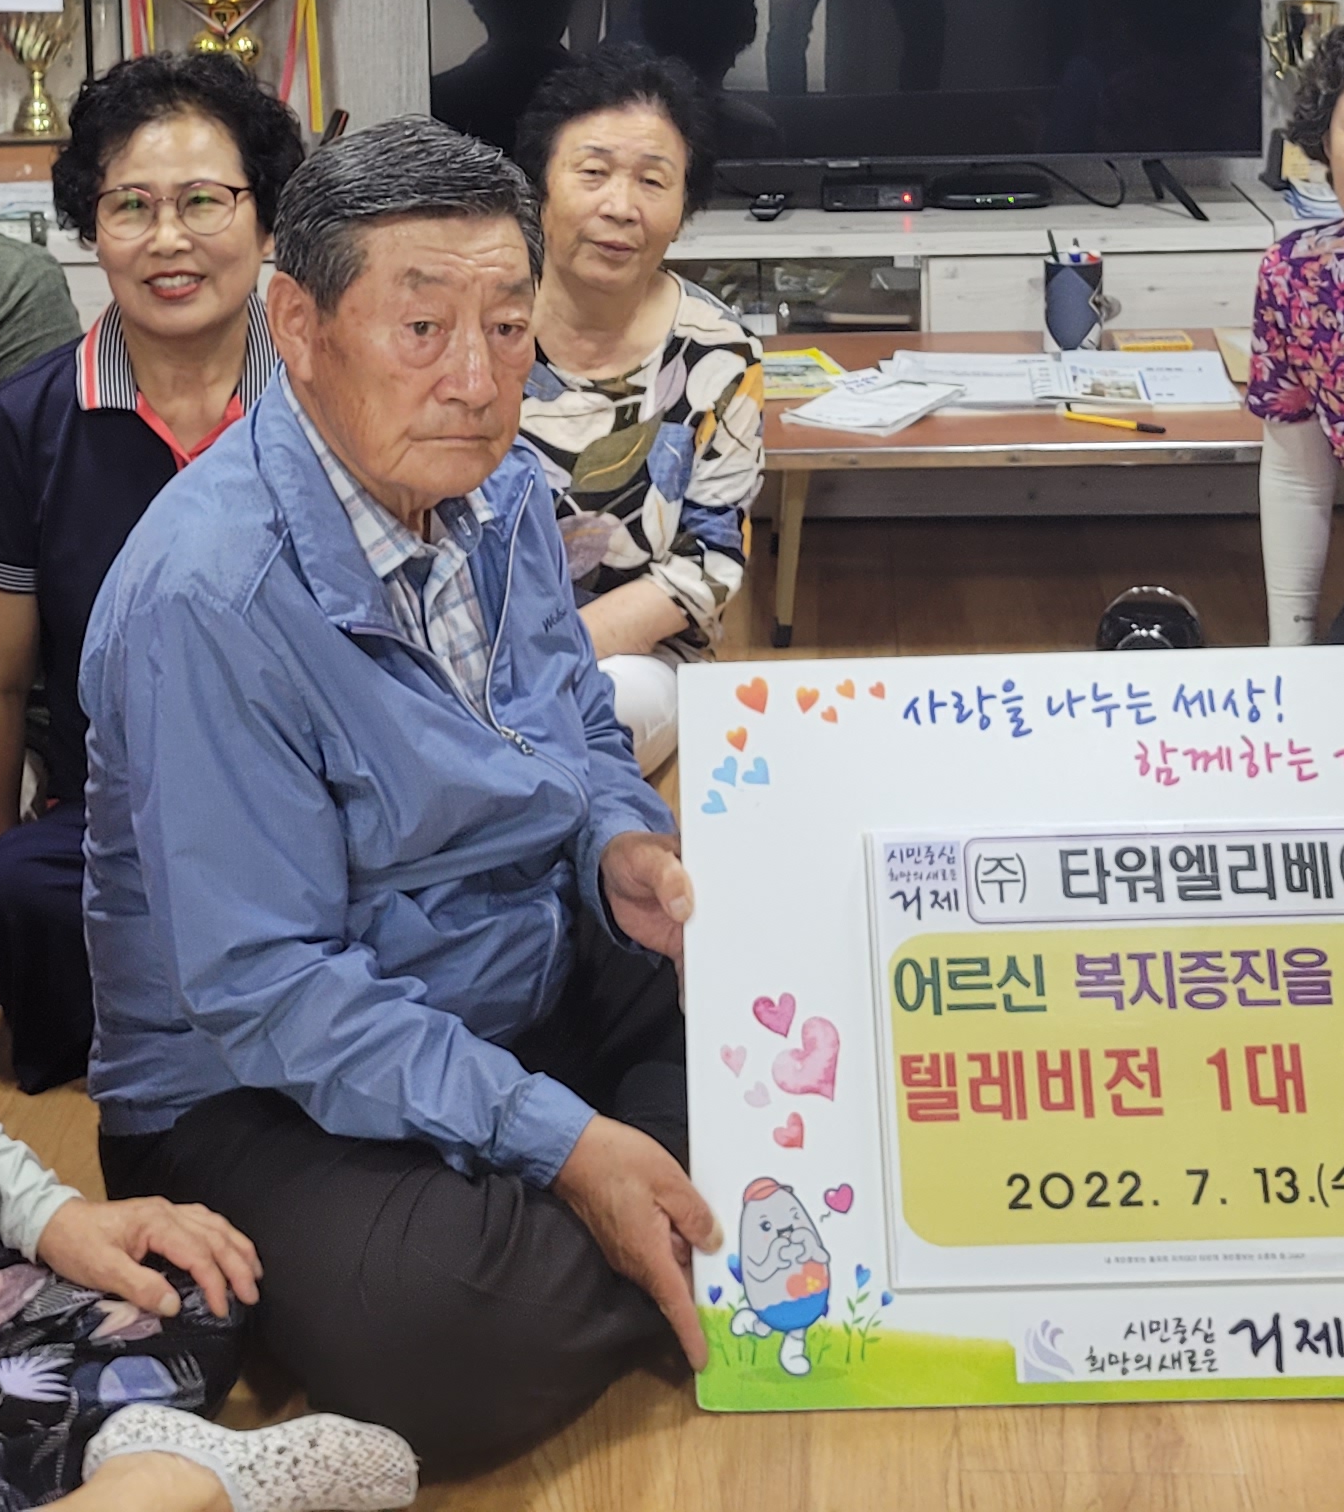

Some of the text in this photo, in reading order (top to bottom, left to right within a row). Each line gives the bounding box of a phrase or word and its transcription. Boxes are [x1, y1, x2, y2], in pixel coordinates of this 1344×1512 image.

[903, 675, 1284, 738] 사랑을 나누는 세상!
[1134, 735, 1318, 786] 함께하는
[887, 845, 956, 865] 시민중심
[974, 853, 1027, 904] (주)
[889, 886, 959, 920] 거제
[894, 954, 1047, 1015] 어르신
[1074, 946, 1333, 1011] 복지증진을
[899, 1046, 1164, 1123] 텔레비전
[1205, 1042, 1308, 1114] 1대
[1007, 1170, 1159, 1210] 2022.
[1185, 1168, 1228, 1207] 7.
[1123, 1317, 1215, 1344] 시민중심
